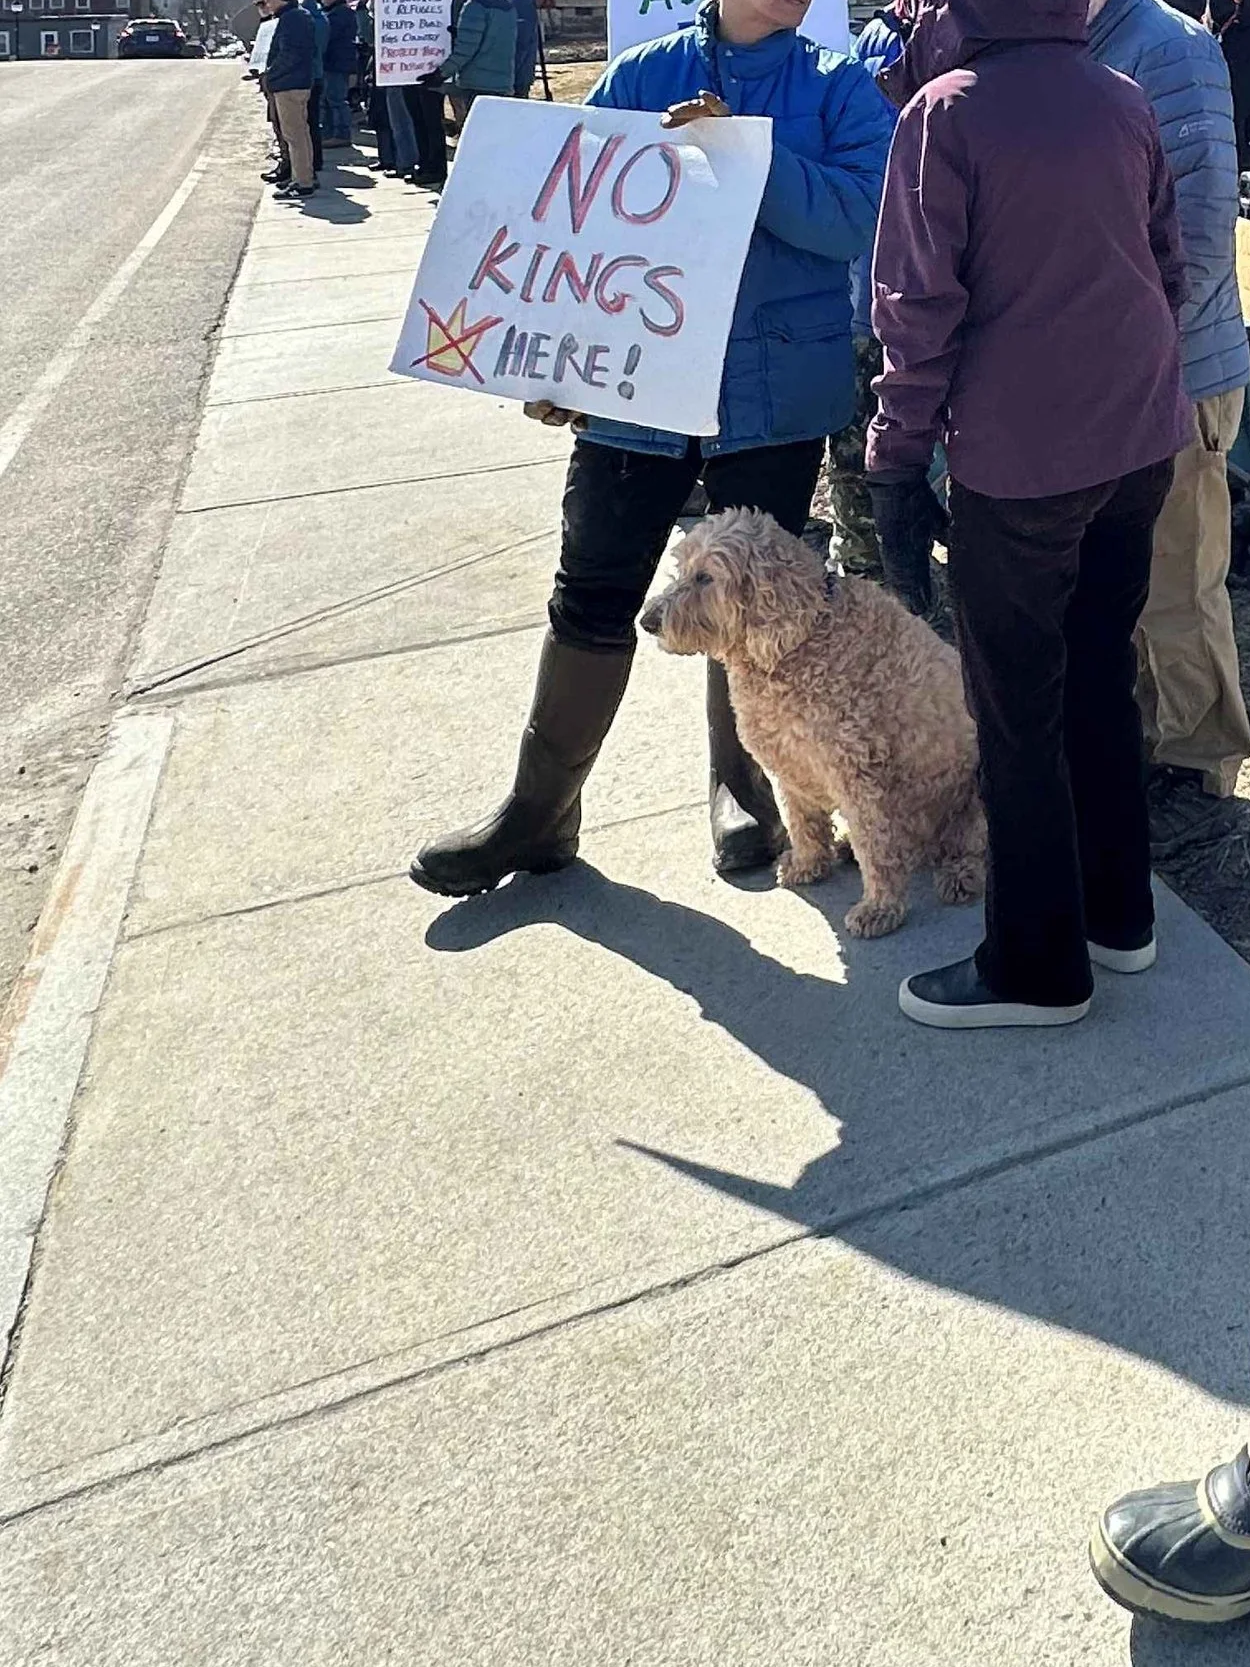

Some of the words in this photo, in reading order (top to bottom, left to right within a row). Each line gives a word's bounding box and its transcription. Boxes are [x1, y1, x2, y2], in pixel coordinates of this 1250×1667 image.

[531, 121, 682, 234] NO
[468, 225, 686, 338] KINGS
[494, 324, 642, 400] HERE!
